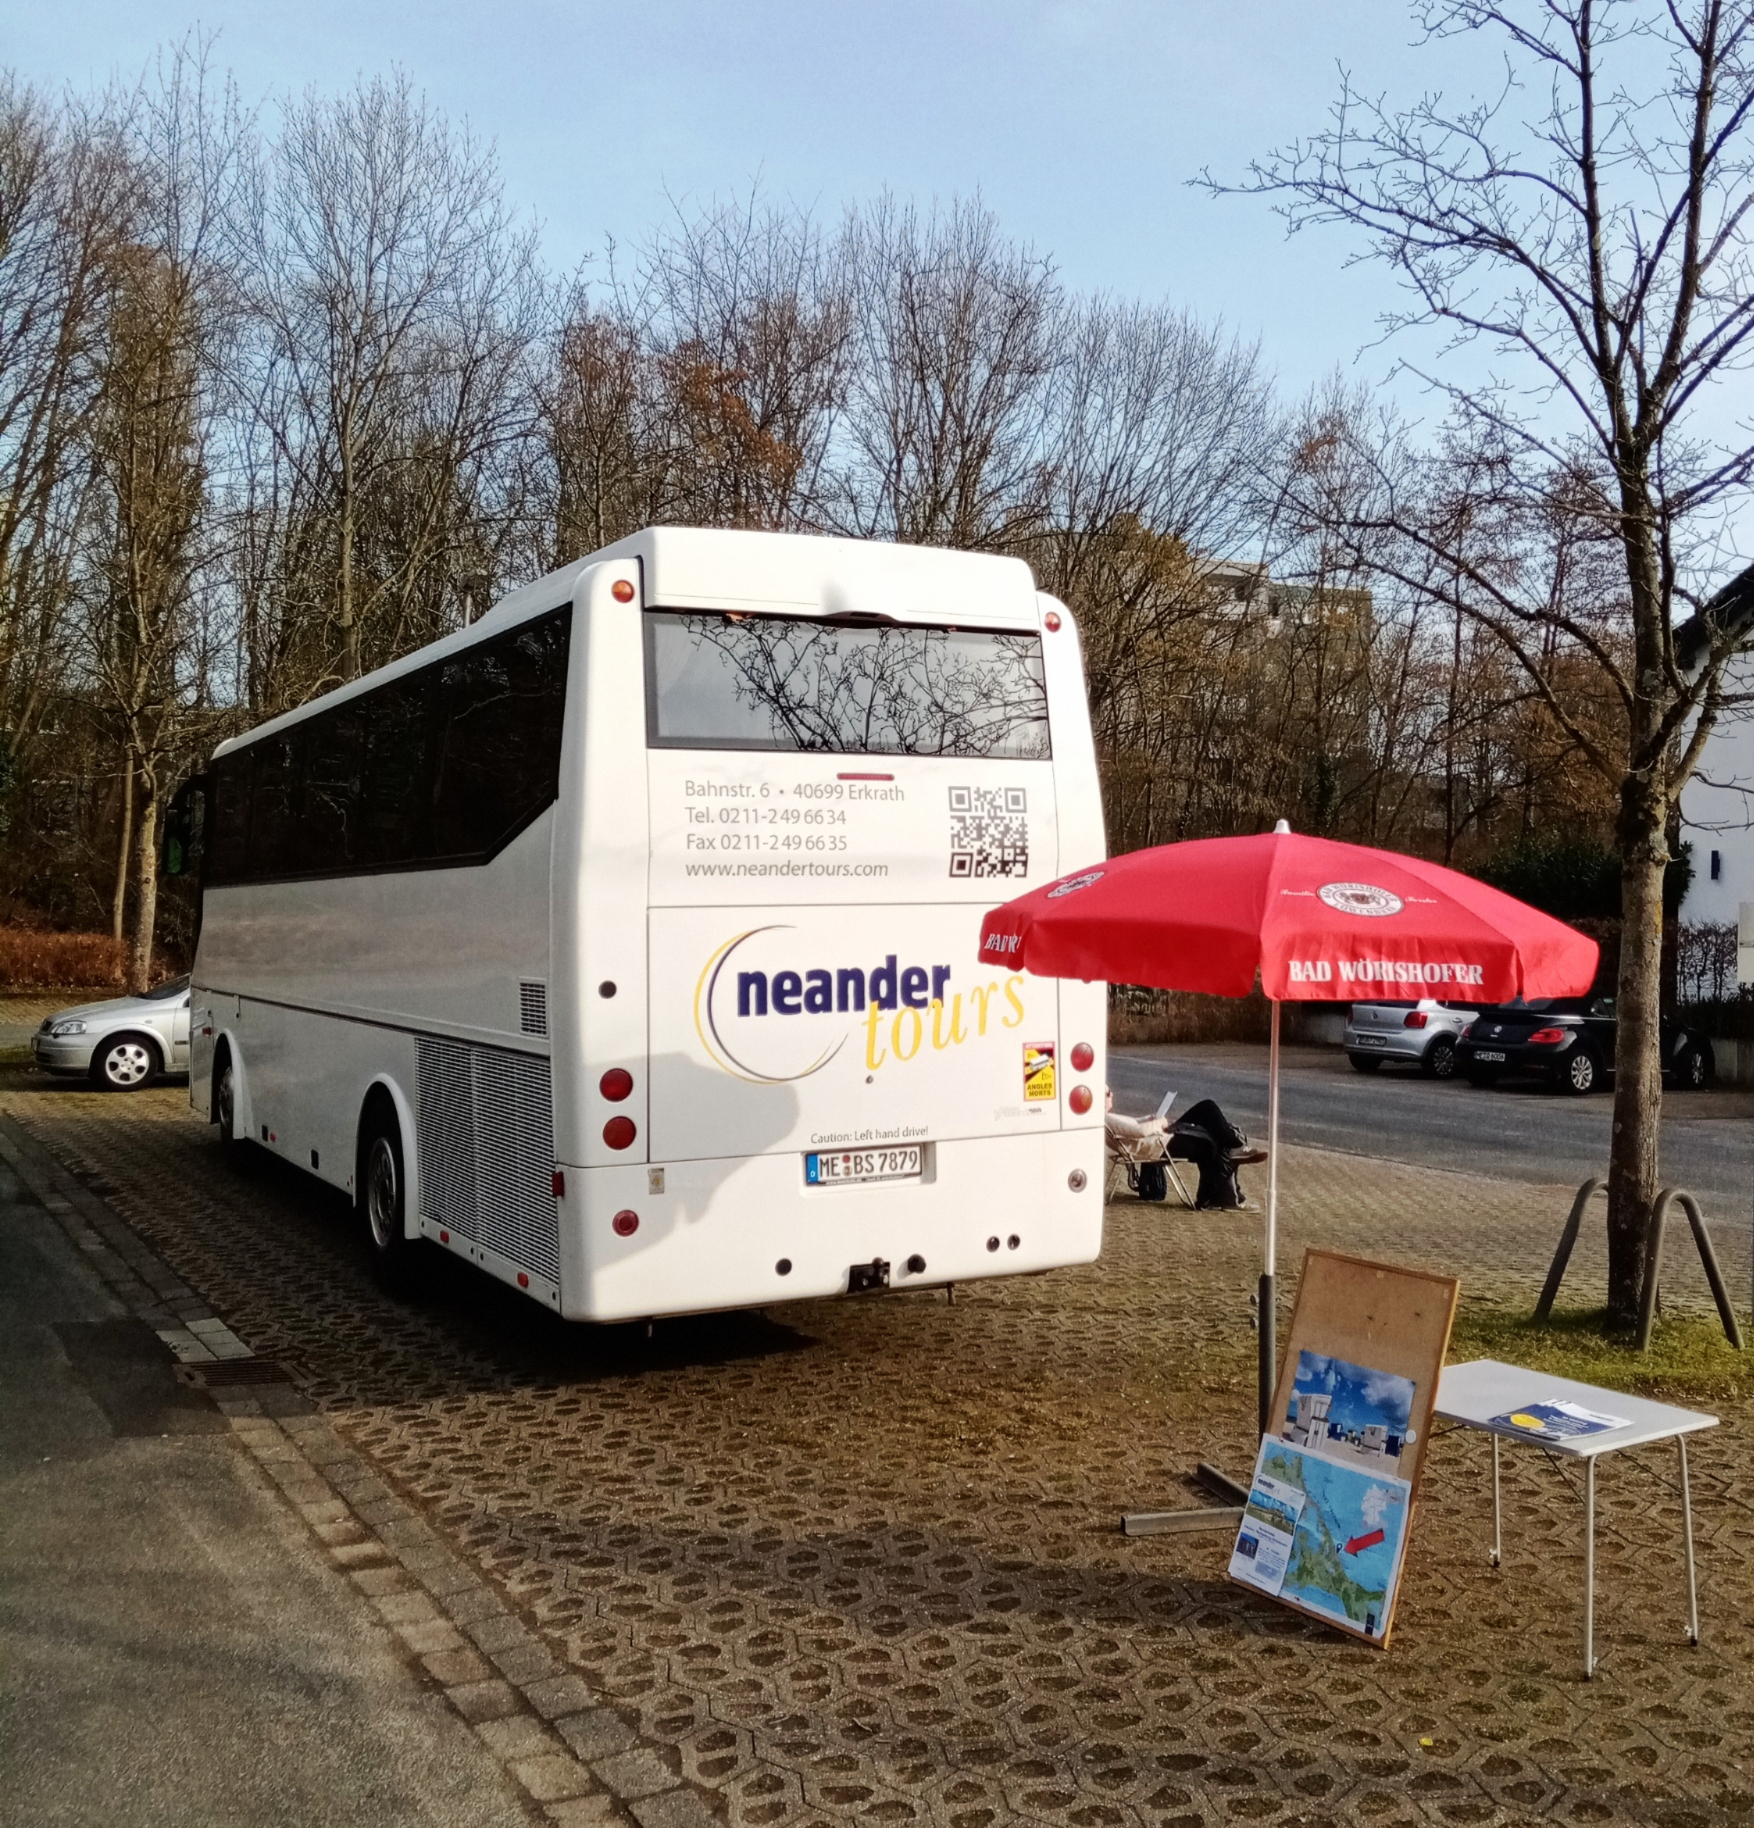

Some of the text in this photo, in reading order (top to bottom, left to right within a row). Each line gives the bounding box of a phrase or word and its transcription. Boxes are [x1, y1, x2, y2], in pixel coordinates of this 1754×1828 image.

[685, 780, 905, 801] Bahnstr. 6 40699 Erkrath
[684, 806, 715, 824] Tel.
[687, 833, 716, 850] Fax
[685, 859, 889, 877] www.neandertours.com
[1288, 958, 1485, 985] BAD WÖRISHOFER
[737, 954, 951, 1017] neander
[861, 974, 1025, 1071] tours
[810, 1126, 929, 1144] Caution: Left hand drive!
